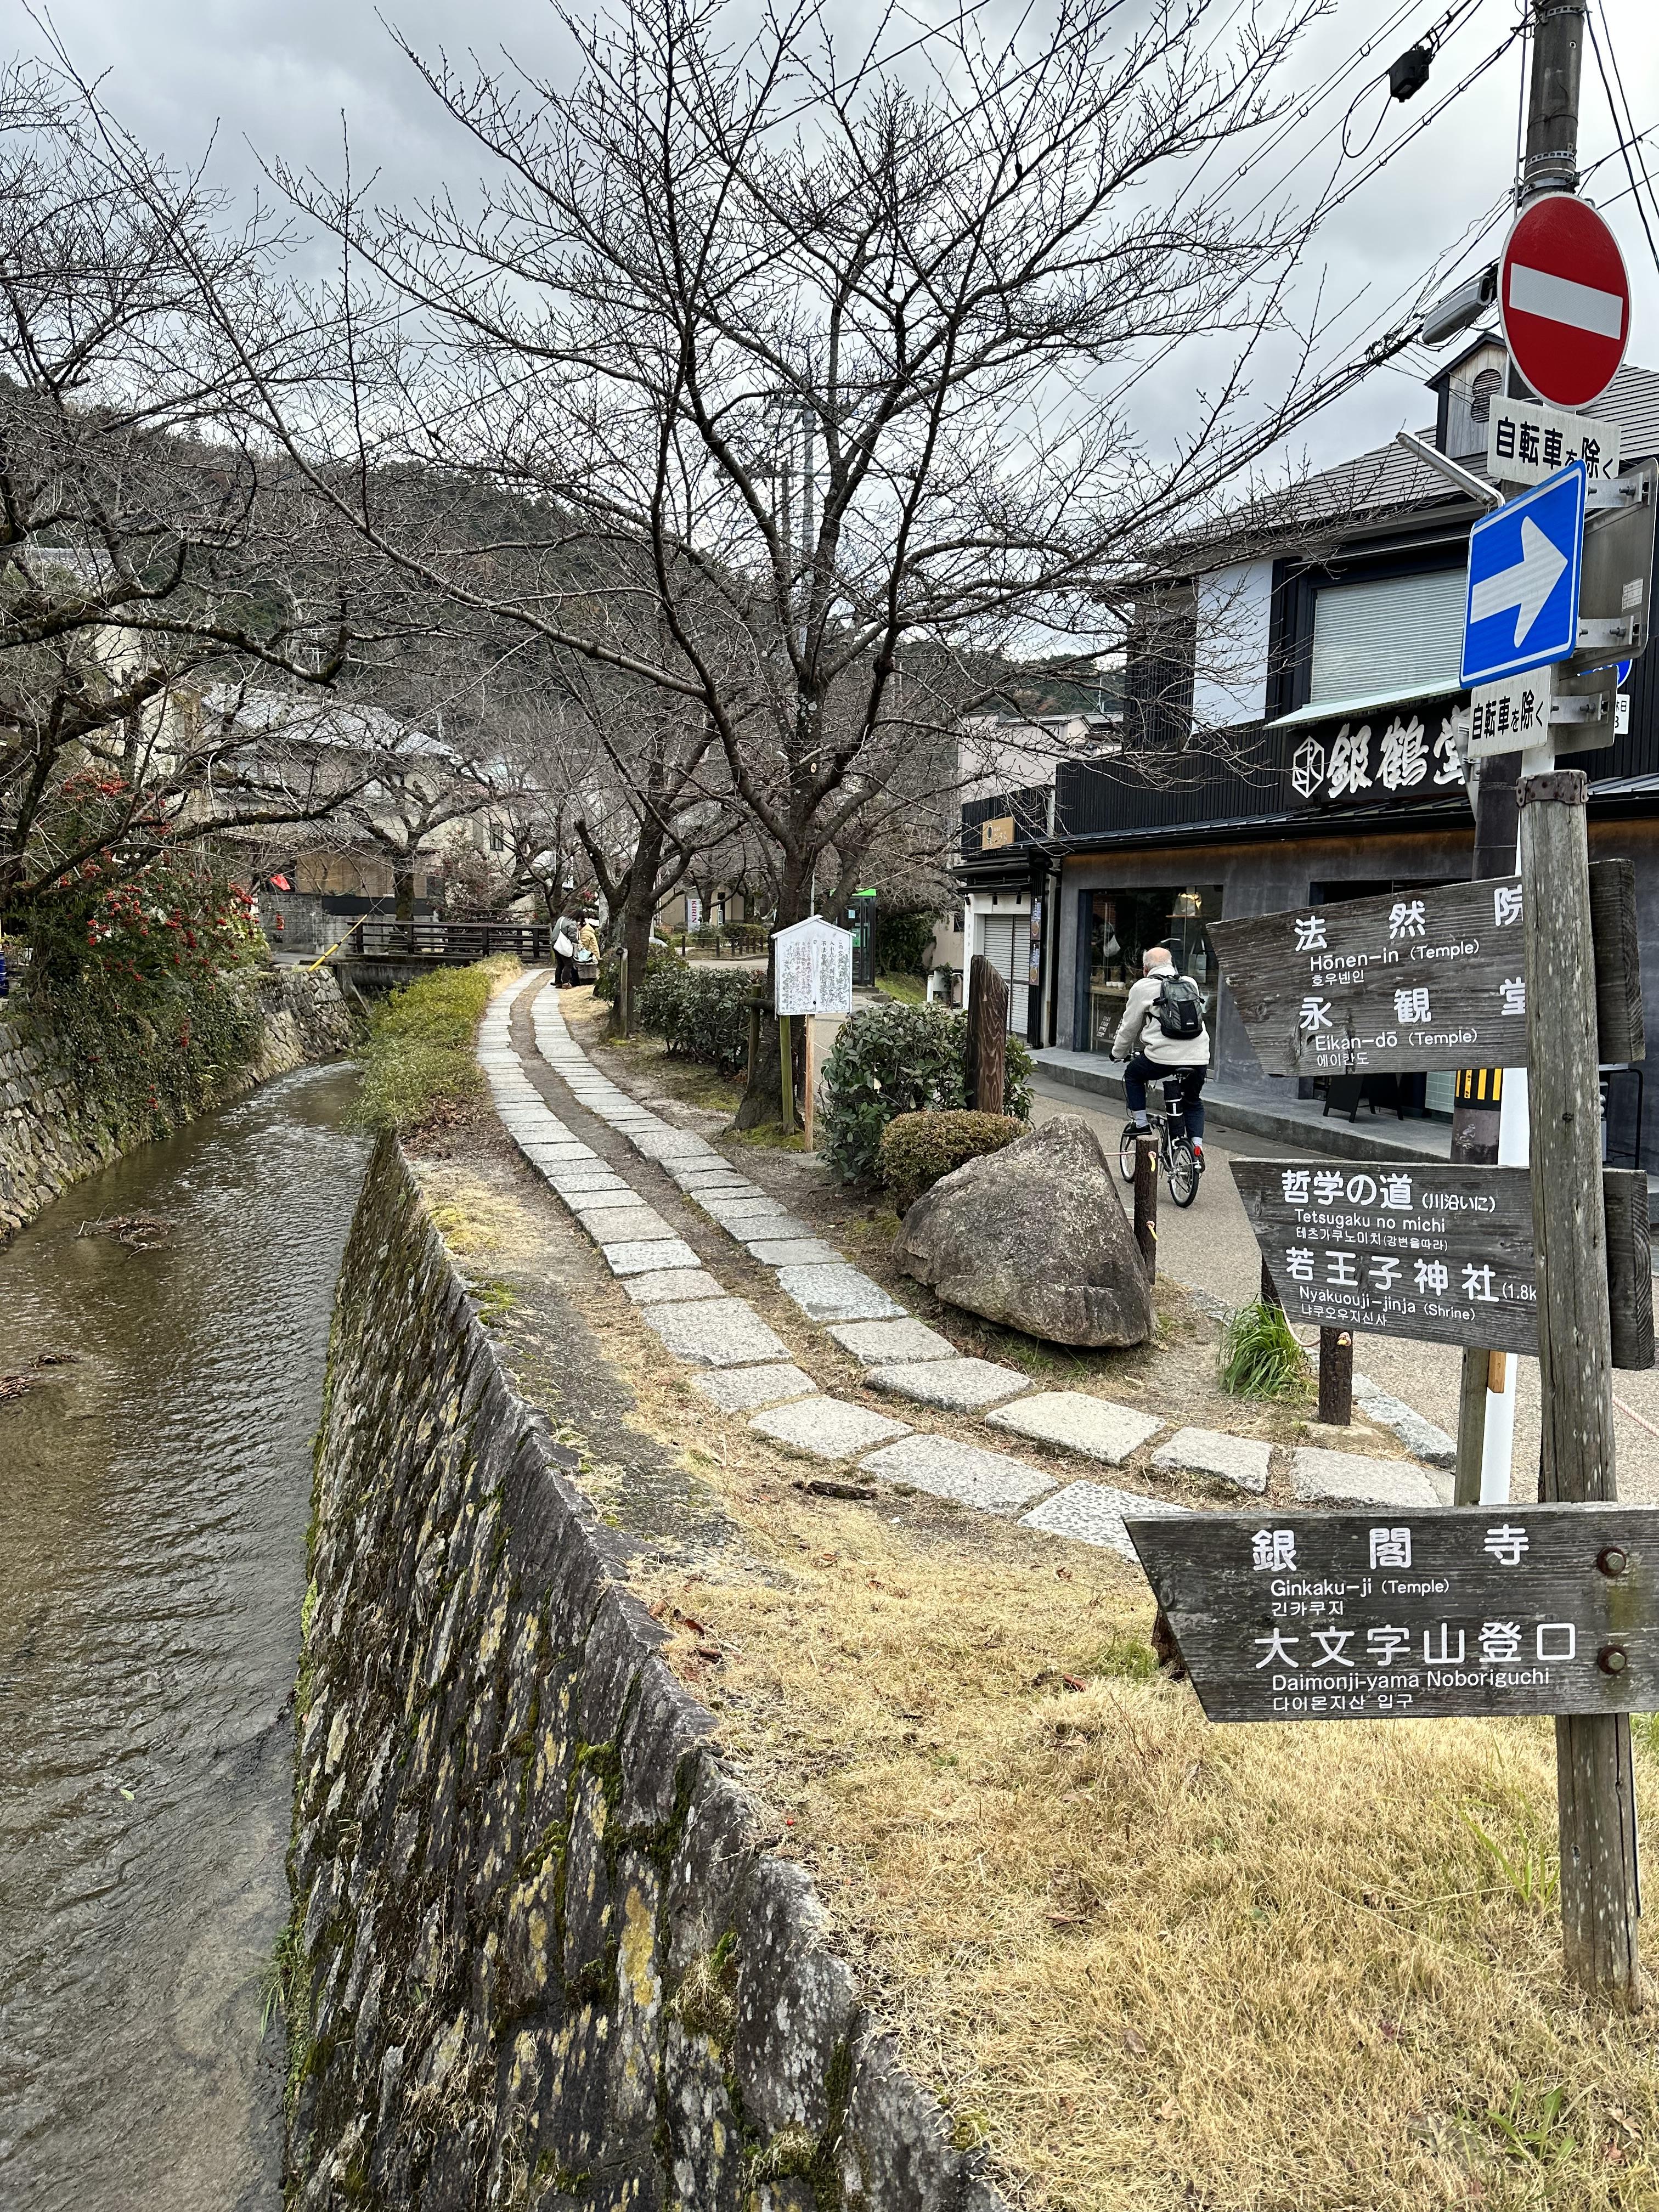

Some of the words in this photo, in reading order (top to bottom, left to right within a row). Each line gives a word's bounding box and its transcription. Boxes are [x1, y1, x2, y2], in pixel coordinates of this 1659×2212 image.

[1496, 416, 1613, 479] 自転車を除く
[1472, 689, 1543, 741] 自転車を除く
[1410, 939, 1480, 961] (Temple)
[1312, 969, 1364, 987] 호우넨인
[1409, 1029, 1477, 1047] (Temple)
[1317, 1052, 1369, 1067] 에이칸도
[1282, 1169, 1413, 1210] 哲学の道
[1294, 1209, 1370, 1230] Tetsugaku
[1377, 1216, 1396, 1229] no
[1403, 1216, 1446, 1233] michi
[1285, 1246, 1499, 1302] 若王子神社
[1300, 1285, 1416, 1313] Nyakuouji-jinja
[1424, 1303, 1476, 1322] (Shrine)
[1301, 1303, 1387, 1327] 냐쿠오우지신사
[1251, 1523, 1530, 1572] 銀閣寺
[1270, 1578, 1372, 1598] Ginkaku-ji
[1381, 1578, 1449, 1596] (Temple)
[1271, 1600, 1344, 1616] 긴카쿠지
[1254, 1622, 1576, 1669] 大文字山登口
[1272, 1672, 1419, 1692] Daimonji-yama
[1426, 1668, 1549, 1689] Noboriguchi
[1273, 1694, 1365, 1712] 다이몬지산
[1376, 1693, 1414, 1709] 입구
